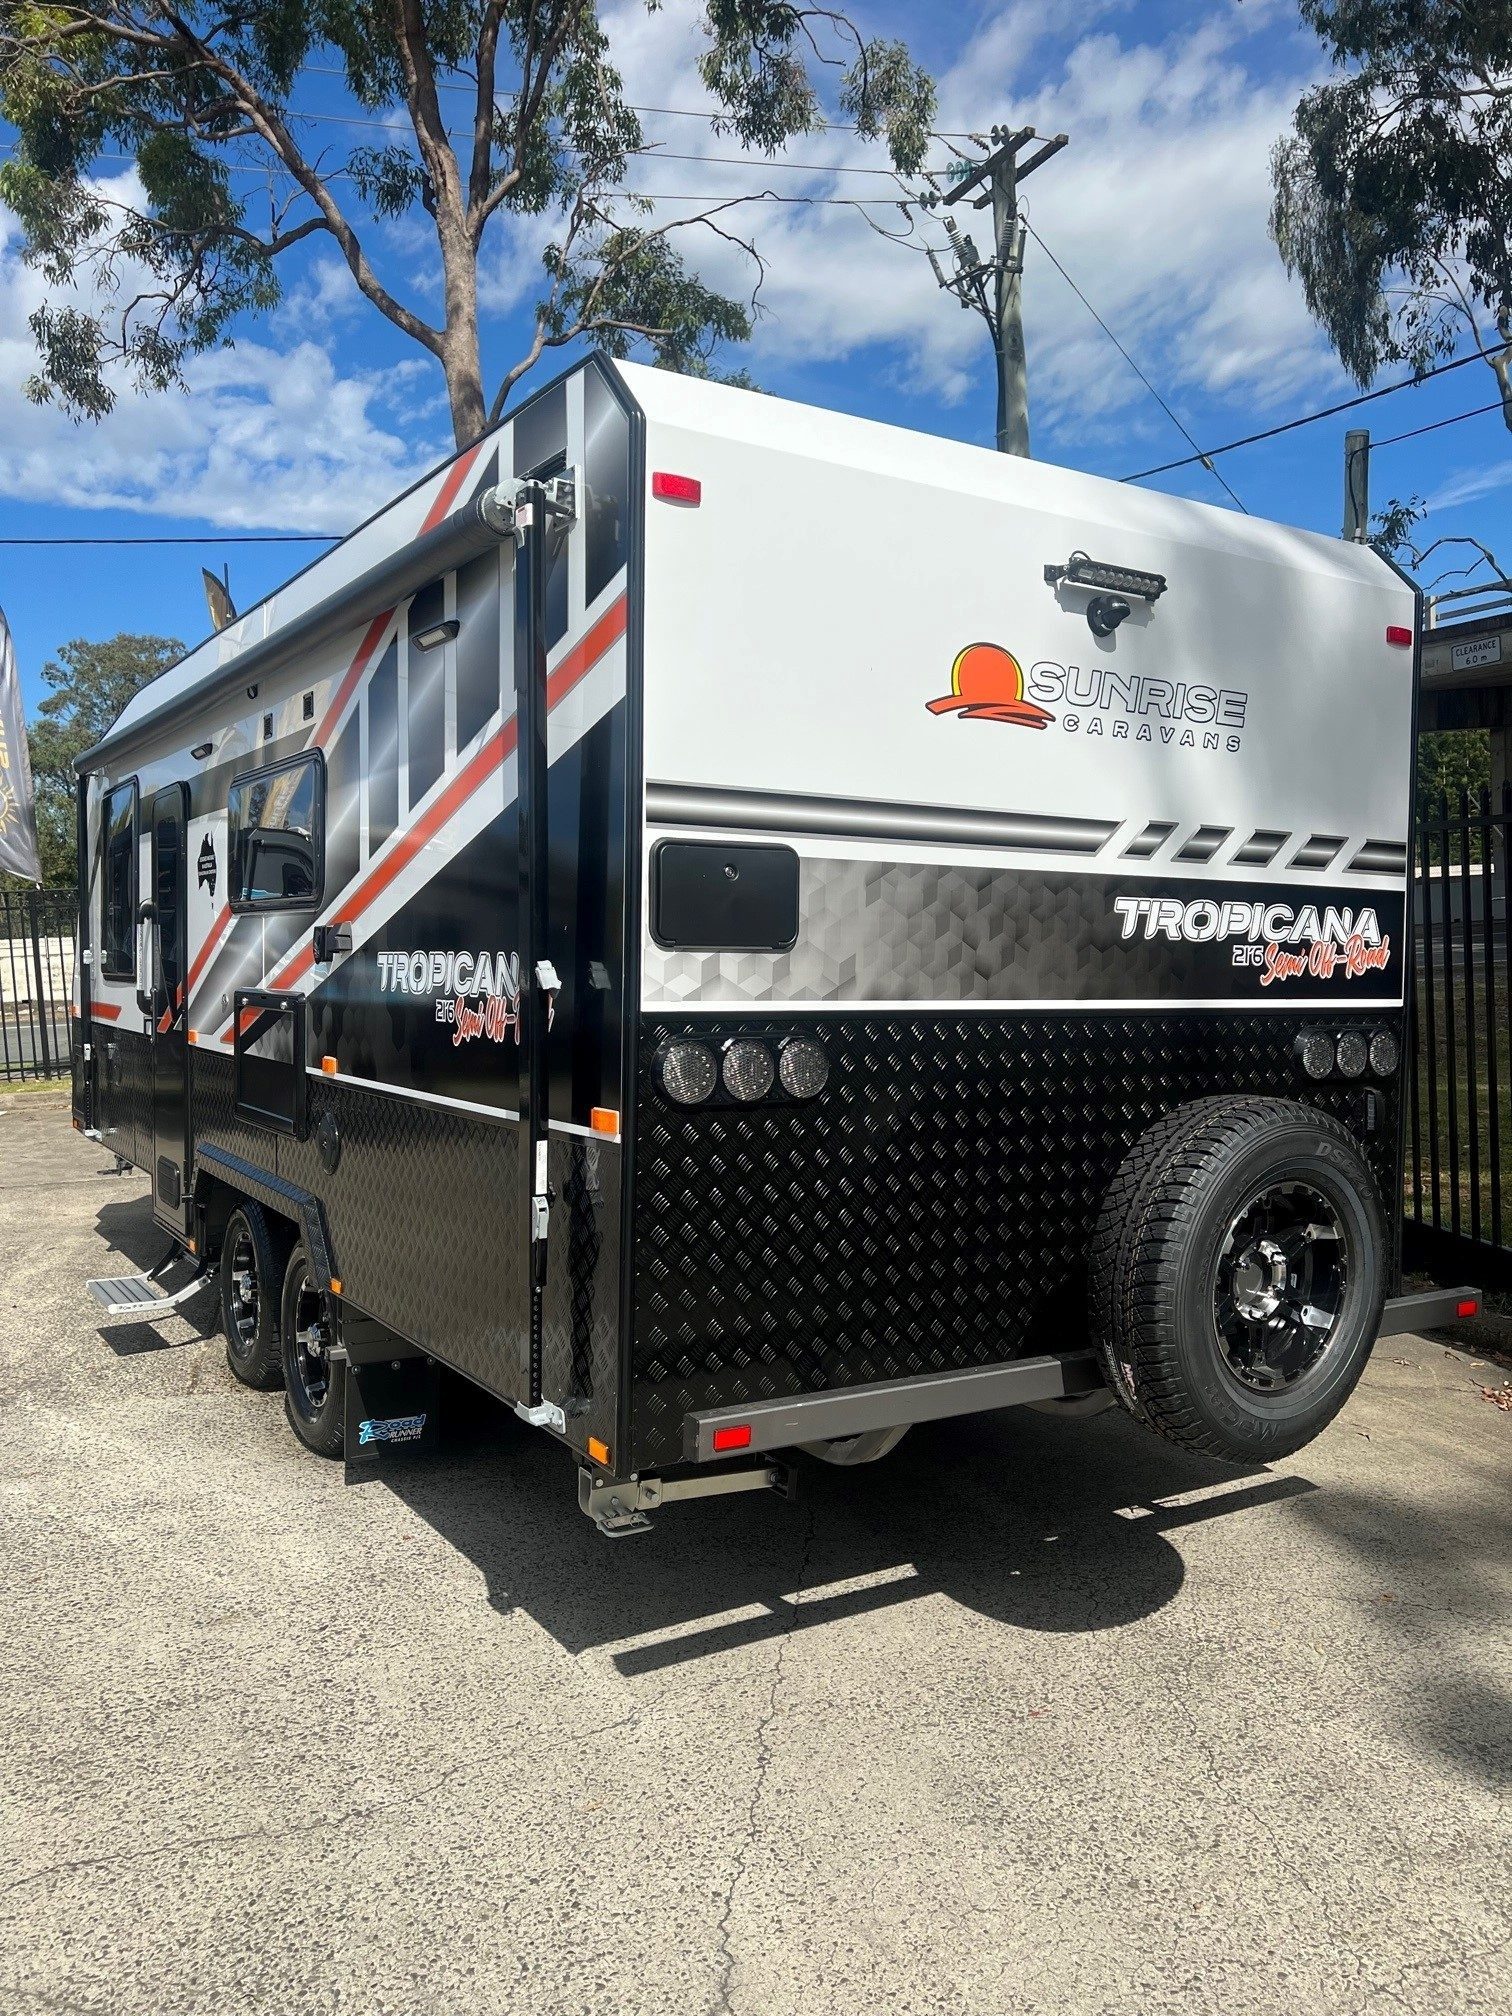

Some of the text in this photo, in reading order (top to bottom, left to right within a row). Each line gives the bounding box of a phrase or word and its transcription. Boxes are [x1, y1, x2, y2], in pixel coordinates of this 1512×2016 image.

[1456, 640, 1496, 656] CLEARANCE
[1028, 661, 1248, 728] SUNRISE
[1062, 713, 1241, 752] CARAVANS
[1114, 896, 1381, 946] TROPICANA
[377, 950, 520, 999] TROPICAN
[1259, 941, 1308, 986] Semi
[1308, 934, 1391, 979] Off-Road
[452, 996, 486, 1047] Semi
[359, 1414, 426, 1445] Road
[389, 1427, 423, 1439] RUNNER
